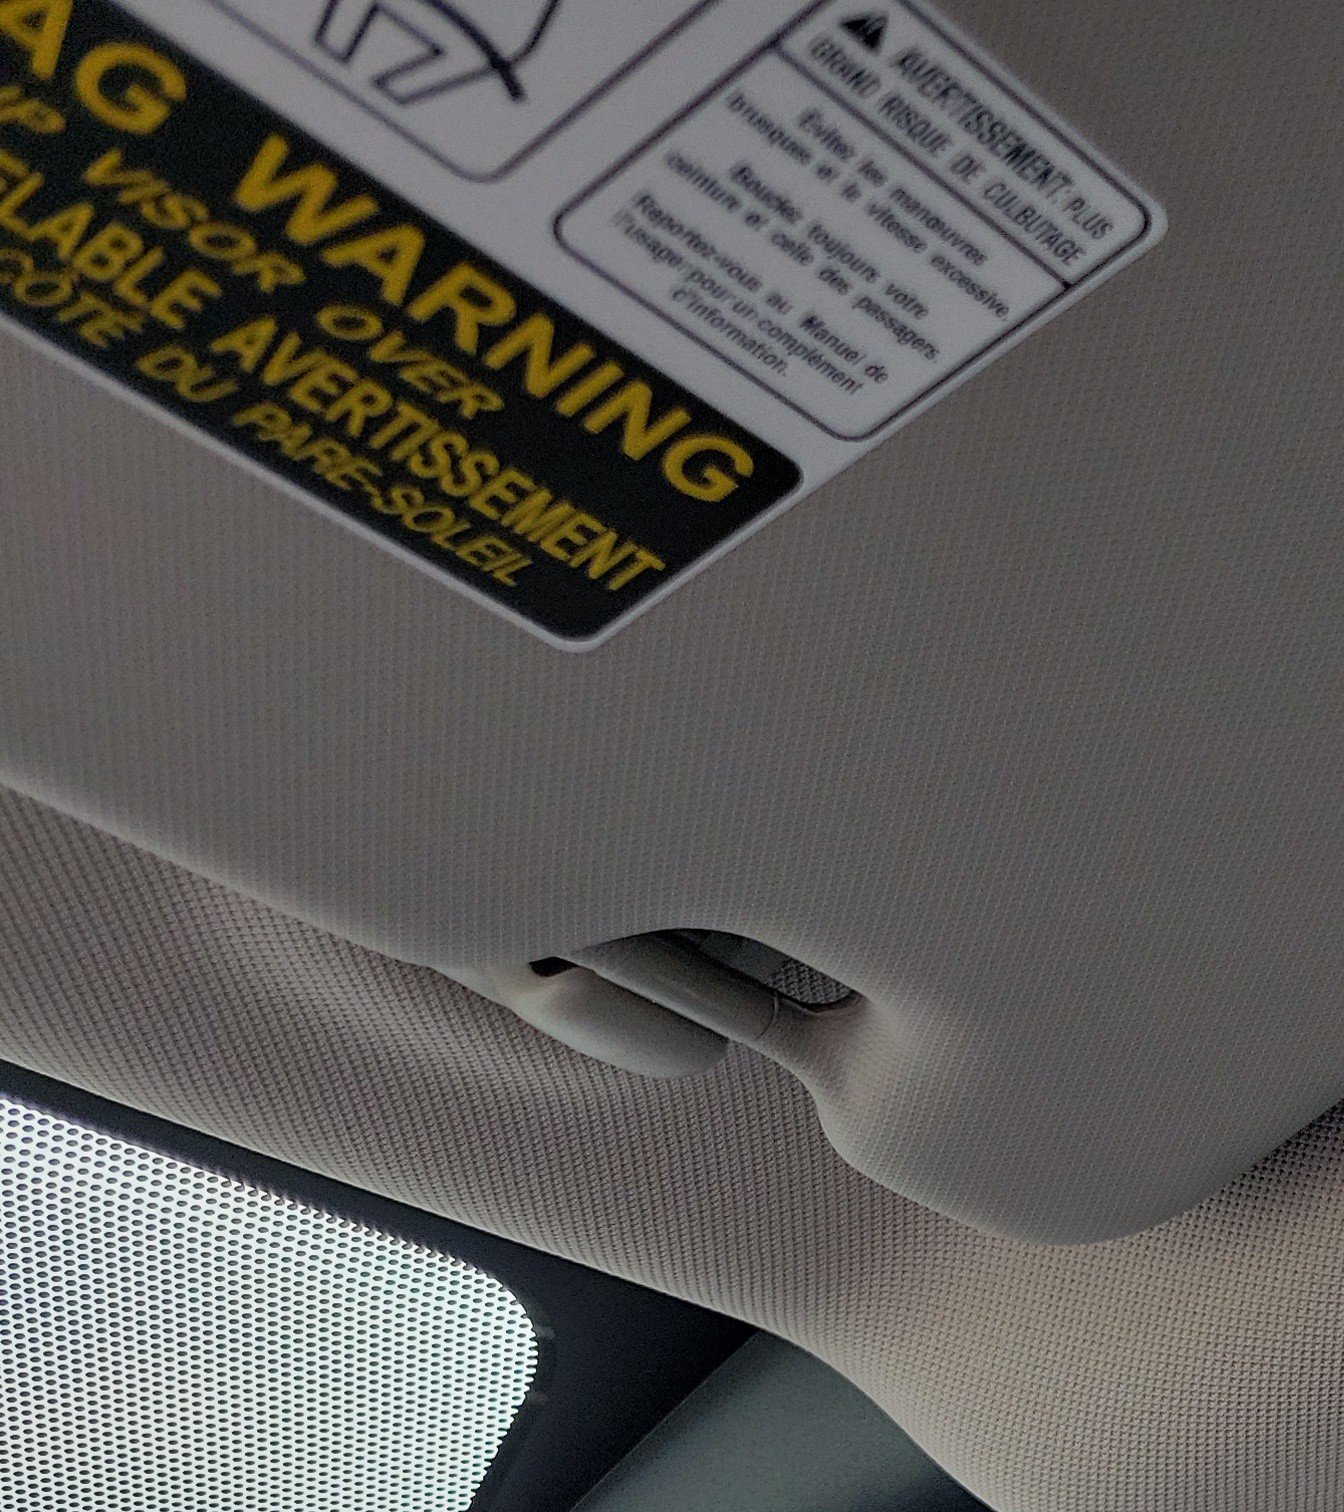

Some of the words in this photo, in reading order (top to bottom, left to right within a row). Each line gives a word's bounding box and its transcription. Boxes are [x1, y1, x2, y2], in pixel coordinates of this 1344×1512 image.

[661, 150, 746, 214] ceinture
[741, 209, 769, 231] et
[767, 228, 818, 267] celle
[816, 264, 856, 295] des
[849, 294, 947, 366] passagers.
[723, 92, 819, 169] brusques
[812, 161, 840, 184] et
[838, 180, 867, 203] la
[861, 198, 932, 254] vitesse
[927, 250, 1019, 321] excessive.
[728, 163, 808, 224] Bouclez
[800, 222, 886, 287] toujours
[880, 280, 933, 320] votre
[803, 33, 884, 101] GRAND
[874, 91, 955, 159] RISQUE
[948, 153, 987, 184] DE
[980, 179, 1087, 267] CULBUTAGE
[856, 159, 893, 188] les
[1060, 195, 1116, 241] PLUS
[83, 149, 305, 293] VISOR
[317, 304, 506, 421] OVER
[234, 134, 756, 505] WARNING
[629, 192, 768, 292] Reportez-vous
[763, 290, 796, 315] au
[795, 312, 870, 366] Manuel
[862, 360, 895, 384] de
[665, 285, 799, 377] d'information.
[683, 267, 734, 305] pour
[750, 315, 866, 397] complément
[135, 344, 238, 404] DU
[232, 402, 535, 588] PARE-SOLEIL
[211, 316, 667, 592] AVERTISSEMENT
